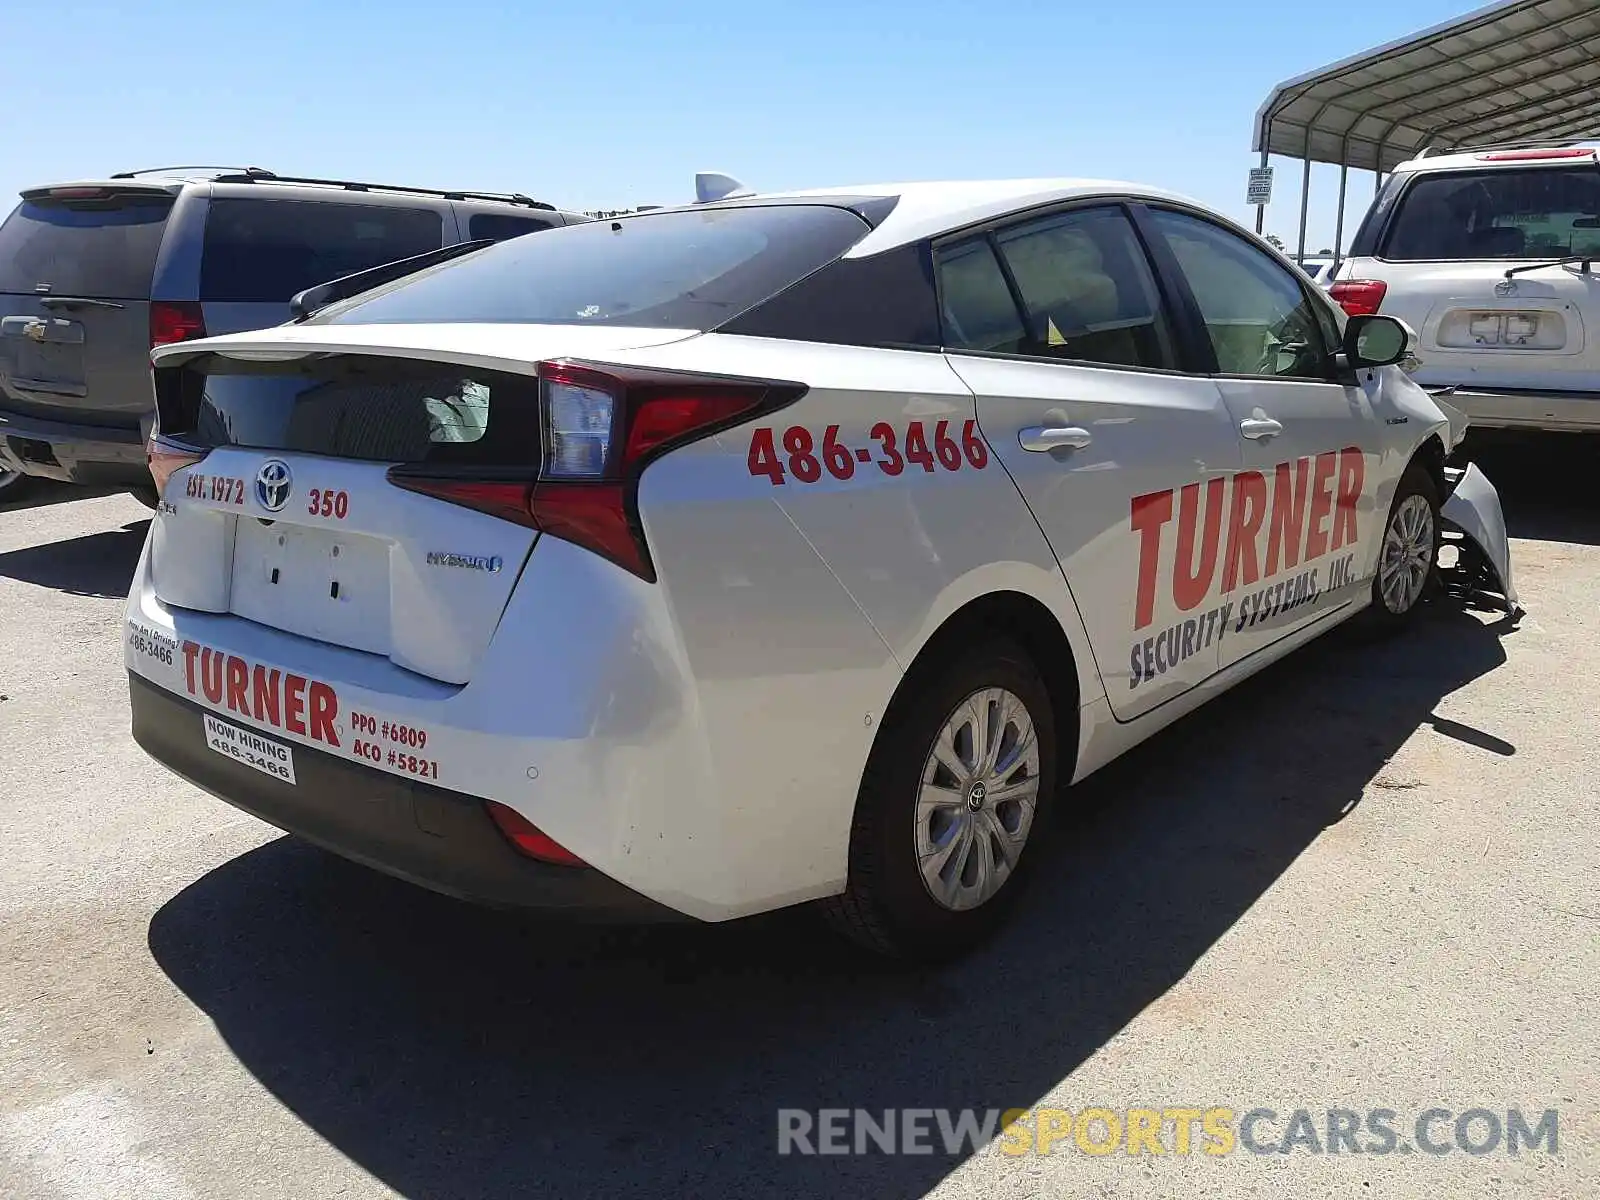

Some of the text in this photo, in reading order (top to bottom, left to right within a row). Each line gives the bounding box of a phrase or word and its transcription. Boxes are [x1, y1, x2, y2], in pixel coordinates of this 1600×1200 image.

[748, 420, 987, 485] 486-3466
[186, 473, 244, 505] EST. 1972
[308, 488, 348, 519] 350
[1130, 446, 1365, 631] TURNER
[1129, 553, 1355, 690] SECURITY SYSTEMS, INC.
[129, 633, 173, 666] 486-3466
[181, 639, 341, 748] TURNER
[207, 718, 288, 762] NOW HIRING
[351, 711, 427, 750] PPO #6809
[211, 738, 291, 779] 486-3466
[353, 738, 438, 780] ACO #5821
